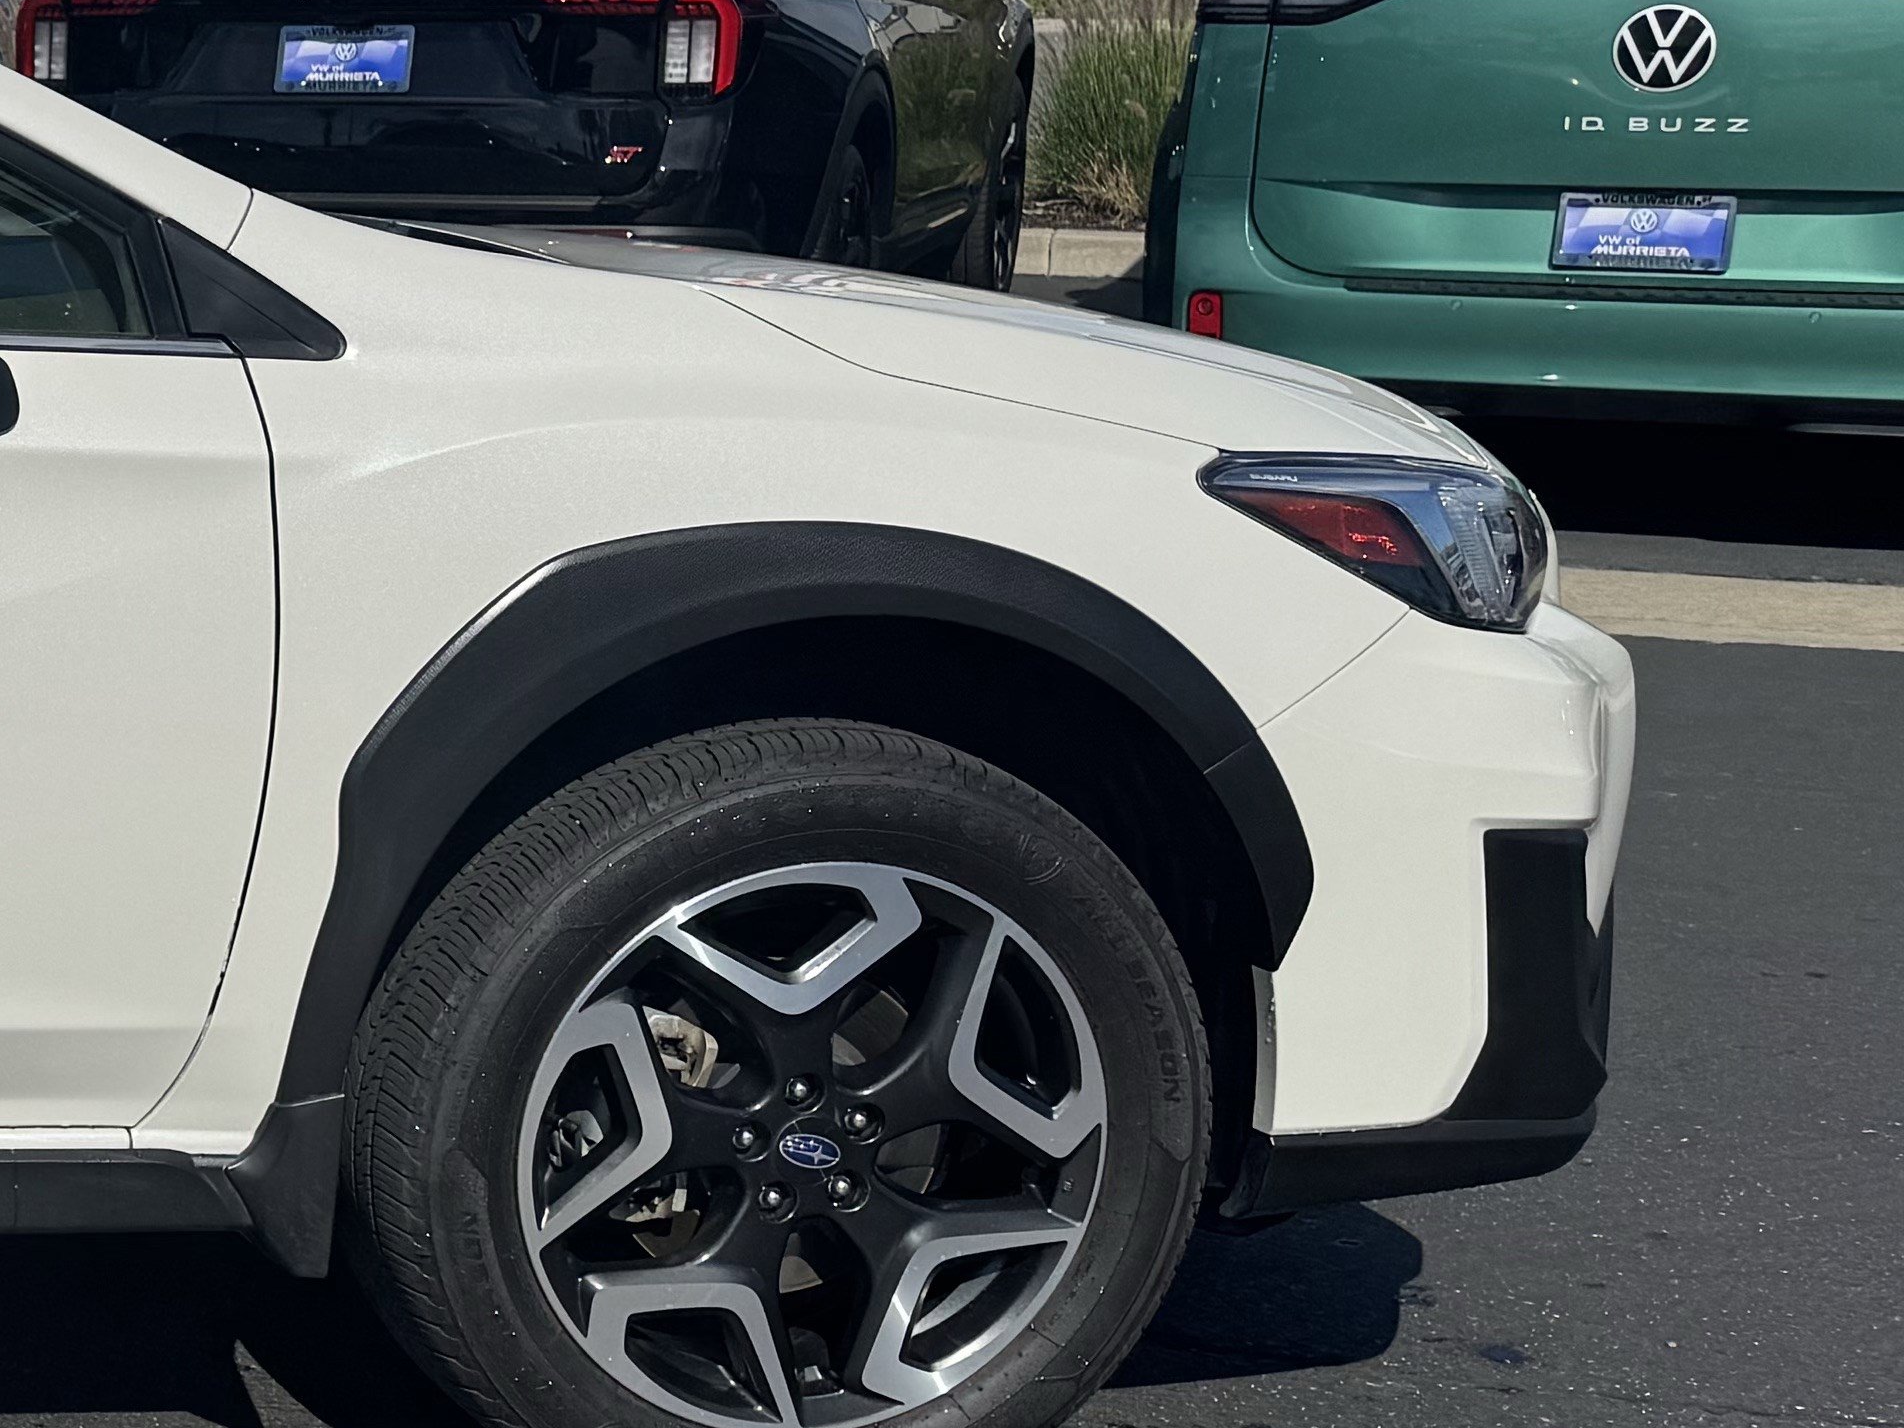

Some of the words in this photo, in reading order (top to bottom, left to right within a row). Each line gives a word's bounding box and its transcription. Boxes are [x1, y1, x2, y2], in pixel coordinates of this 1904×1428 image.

[1628, 116, 1750, 133] BUZZ
[1597, 234, 1622, 245] VW
[1590, 245, 1691, 258] MURRIETA
